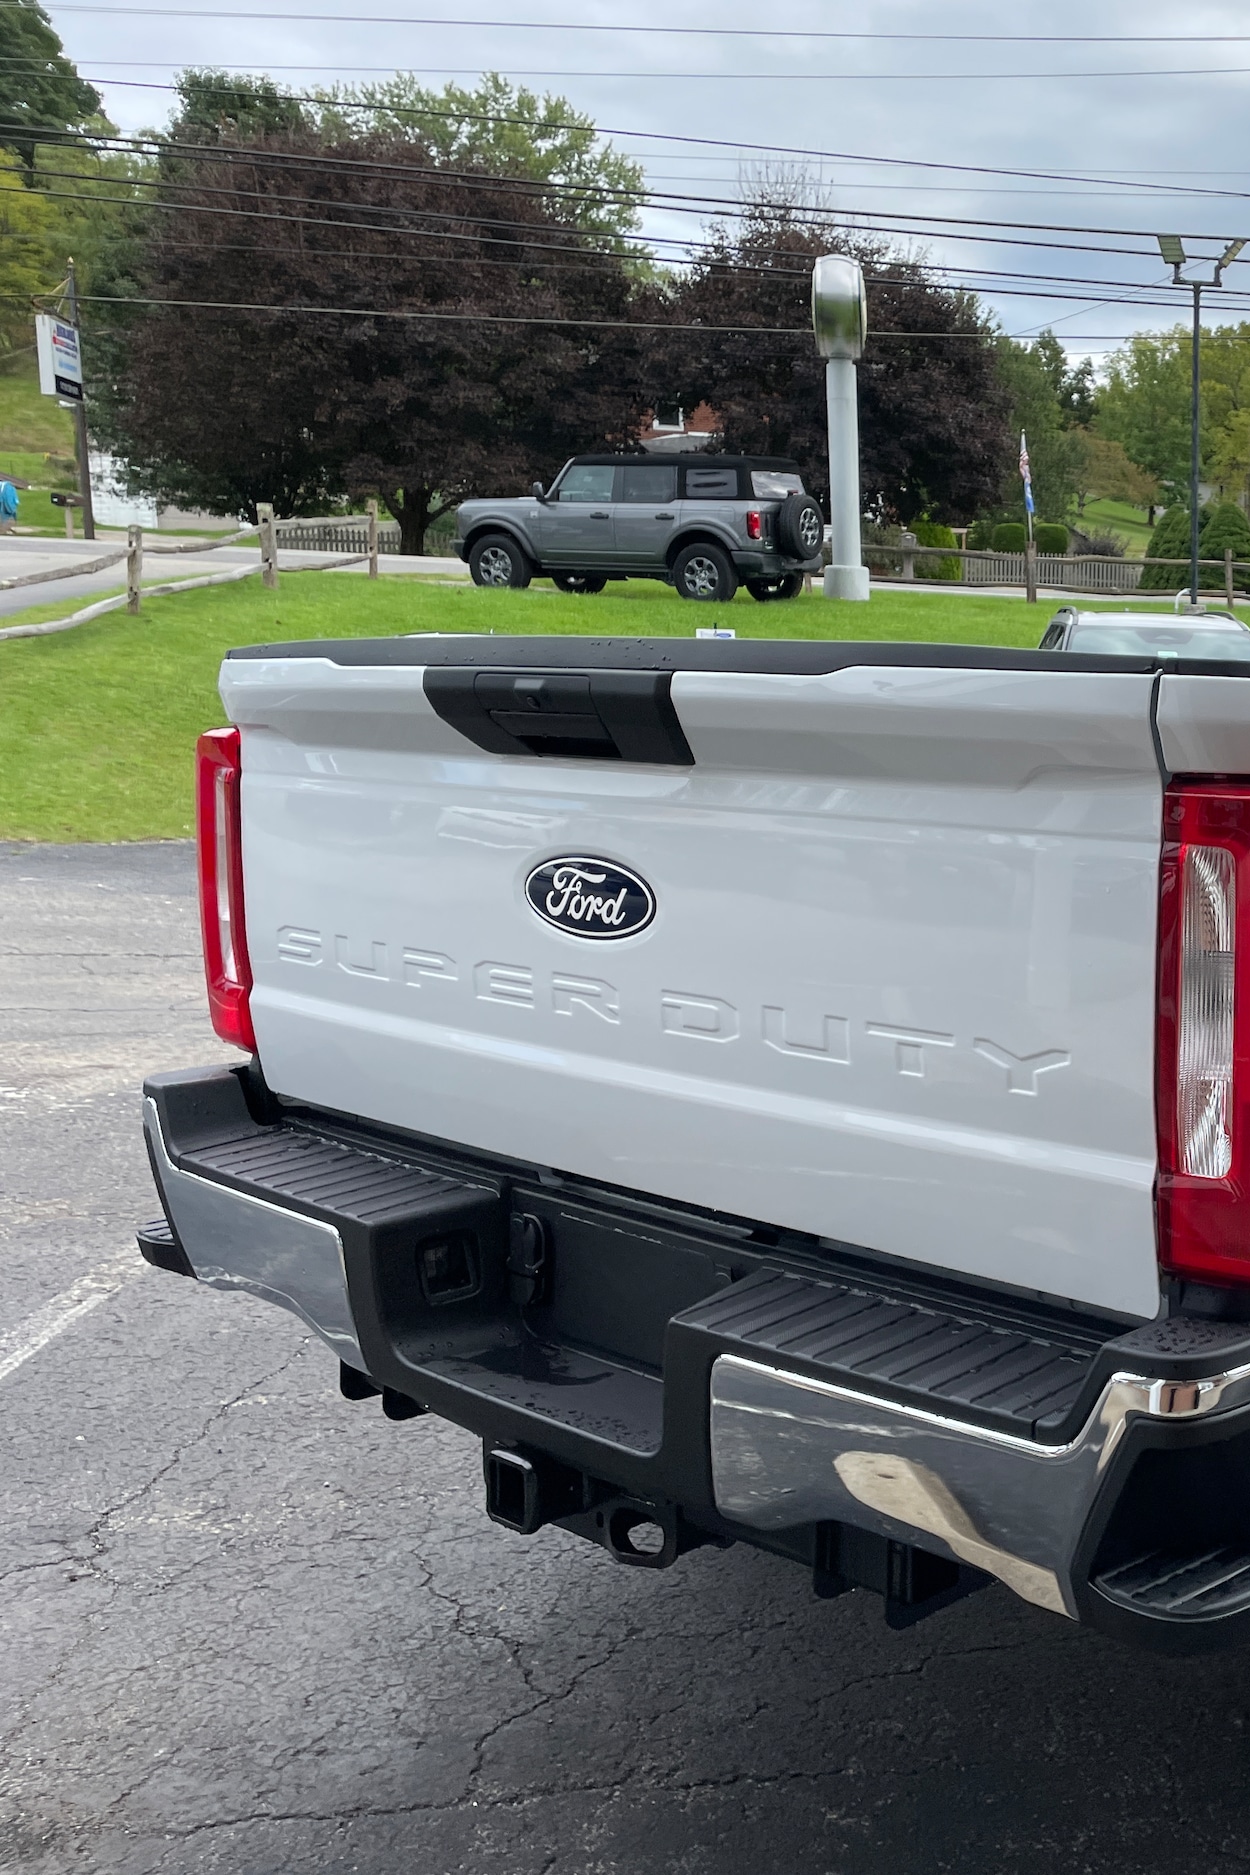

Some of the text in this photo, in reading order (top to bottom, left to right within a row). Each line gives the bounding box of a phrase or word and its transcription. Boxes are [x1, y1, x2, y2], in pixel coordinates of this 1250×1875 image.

[546, 867, 627, 926] Ford
[276, 925, 1072, 1097] SUPER DUTY
